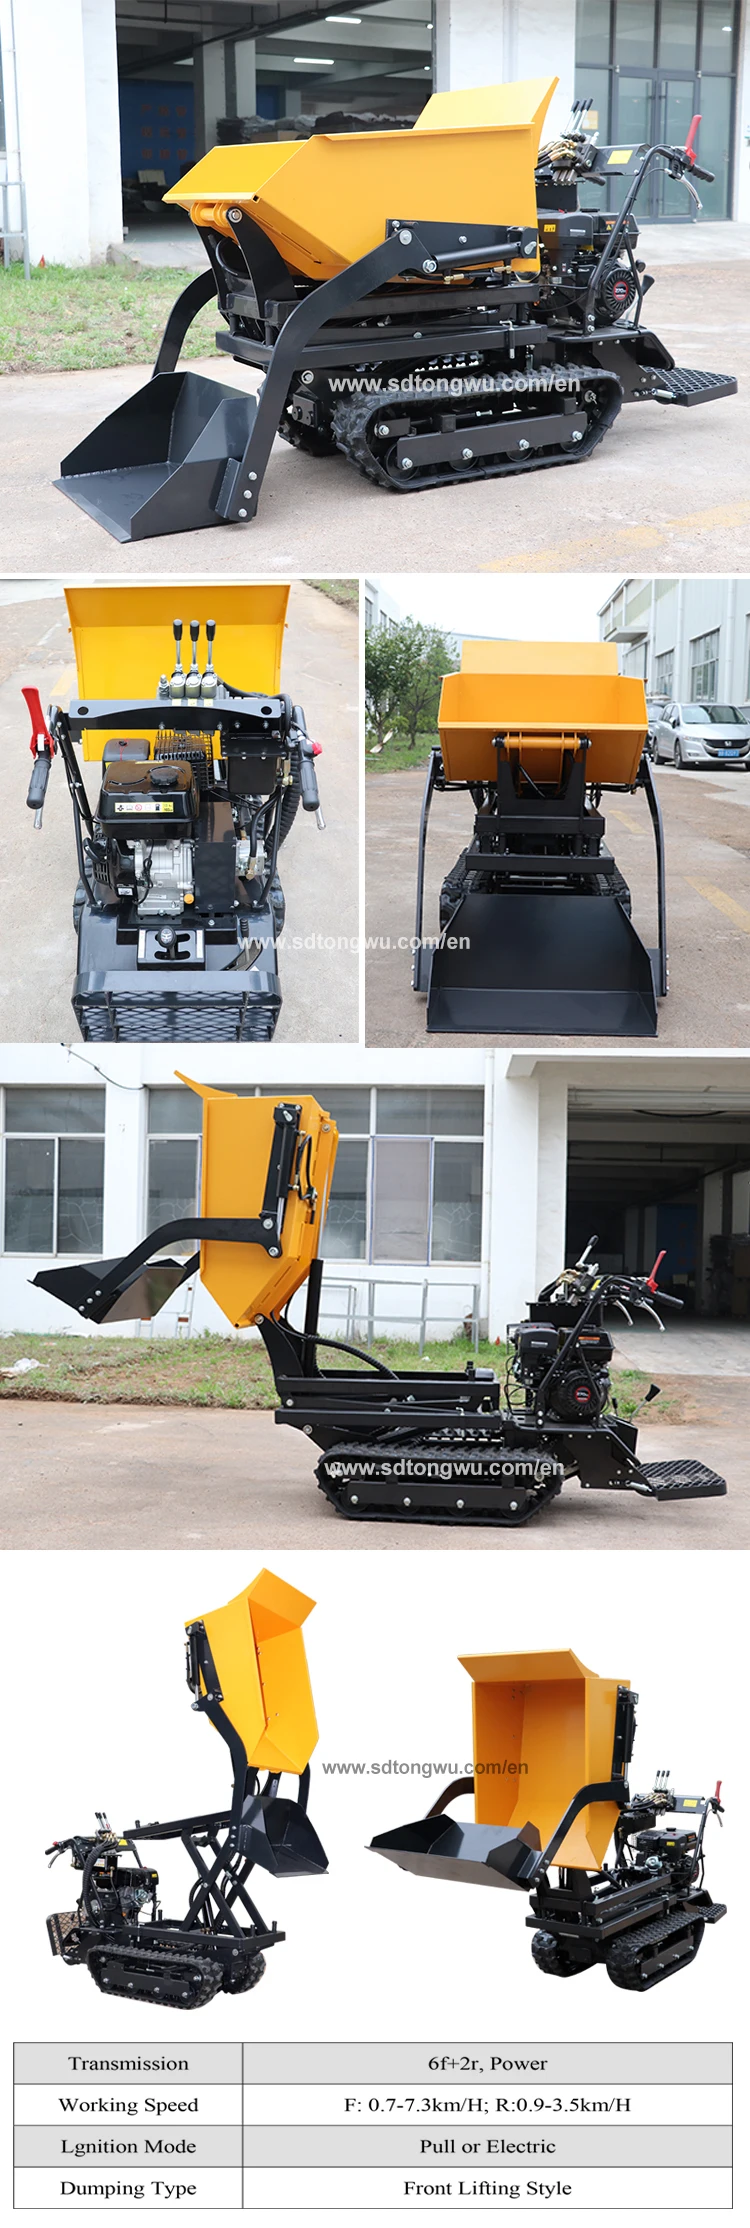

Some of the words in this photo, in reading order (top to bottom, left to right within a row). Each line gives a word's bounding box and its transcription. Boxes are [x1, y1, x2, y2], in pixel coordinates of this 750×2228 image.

[68, 2056, 189, 2071] Transmission
[428, 2056, 484, 2073] 6f+2r,
[490, 2056, 549, 2071] Power
[58, 2098, 138, 2116] Working
[144, 2098, 199, 2116] Speed
[345, 2098, 362, 2112] F:
[368, 2098, 489, 2115] 0.7-7.3km/H;
[495, 2098, 631, 2112] R:0.9-3.5km/H
[61, 2139, 138, 2157] Lgnition
[144, 2139, 197, 2154] Mode
[420, 2139, 455, 2154] Pull
[461, 2143, 482, 2154] or
[486, 2139, 556, 2154] Electric
[60, 2181, 145, 2199] Dumping
[151, 2181, 197, 2199] Type
[403, 2181, 452, 2196] Front
[459, 2181, 521, 2199] Lifting
[526, 2181, 572, 2199] Style
